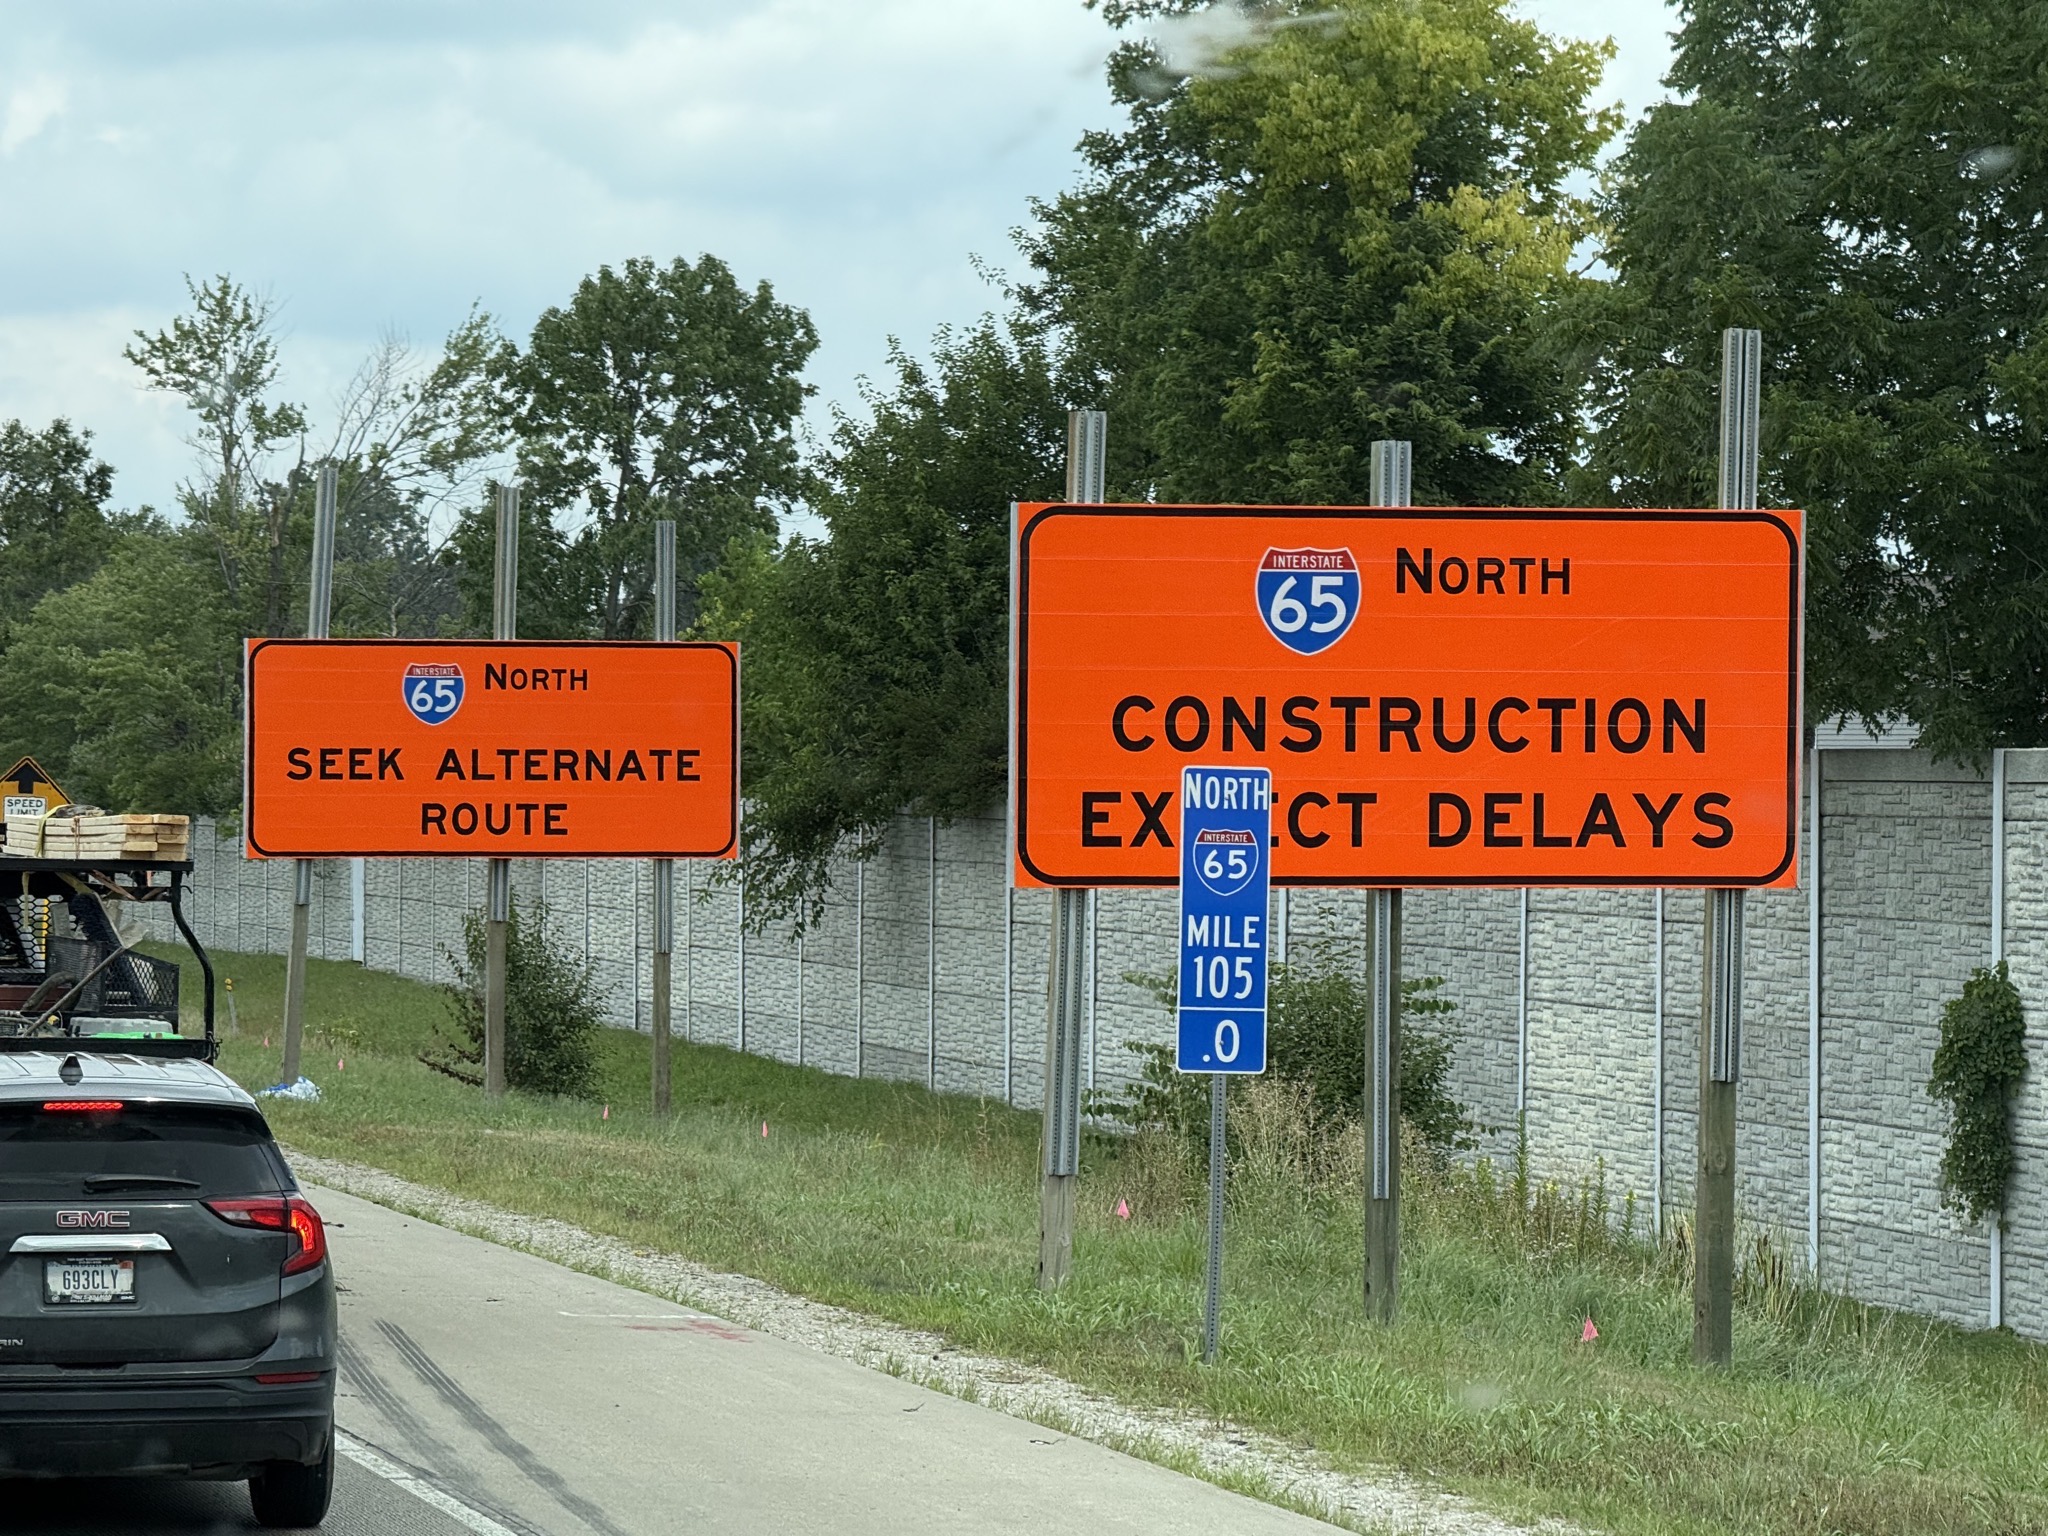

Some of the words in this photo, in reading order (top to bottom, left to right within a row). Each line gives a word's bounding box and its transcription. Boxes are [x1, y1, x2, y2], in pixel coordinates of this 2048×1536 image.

[1273, 555, 1344, 568] INTERSTATE
[1270, 575, 1347, 633] 65
[412, 667, 455, 676] INTERSTATE
[411, 679, 457, 713] 65
[1111, 694, 1706, 755] CONSTRUCTION
[286, 747, 404, 781] SEEK
[435, 748, 701, 782] ALTERNATE
[7, 798, 43, 808] SPEED
[1185, 773, 1269, 811] NORTH
[421, 803, 569, 836] ROUTE
[1082, 791, 1378, 848] EXCT
[1428, 790, 1734, 849] DELAYS
[1204, 833, 1248, 843] INTERSTATE
[1203, 849, 1248, 879] 65
[1187, 915, 1261, 949] MILE
[1193, 956, 1253, 999] 105
[1202, 1019, 1240, 1063] .0
[57, 1211, 130, 1227] GMC
[63, 1269, 118, 1290] 693CLY
